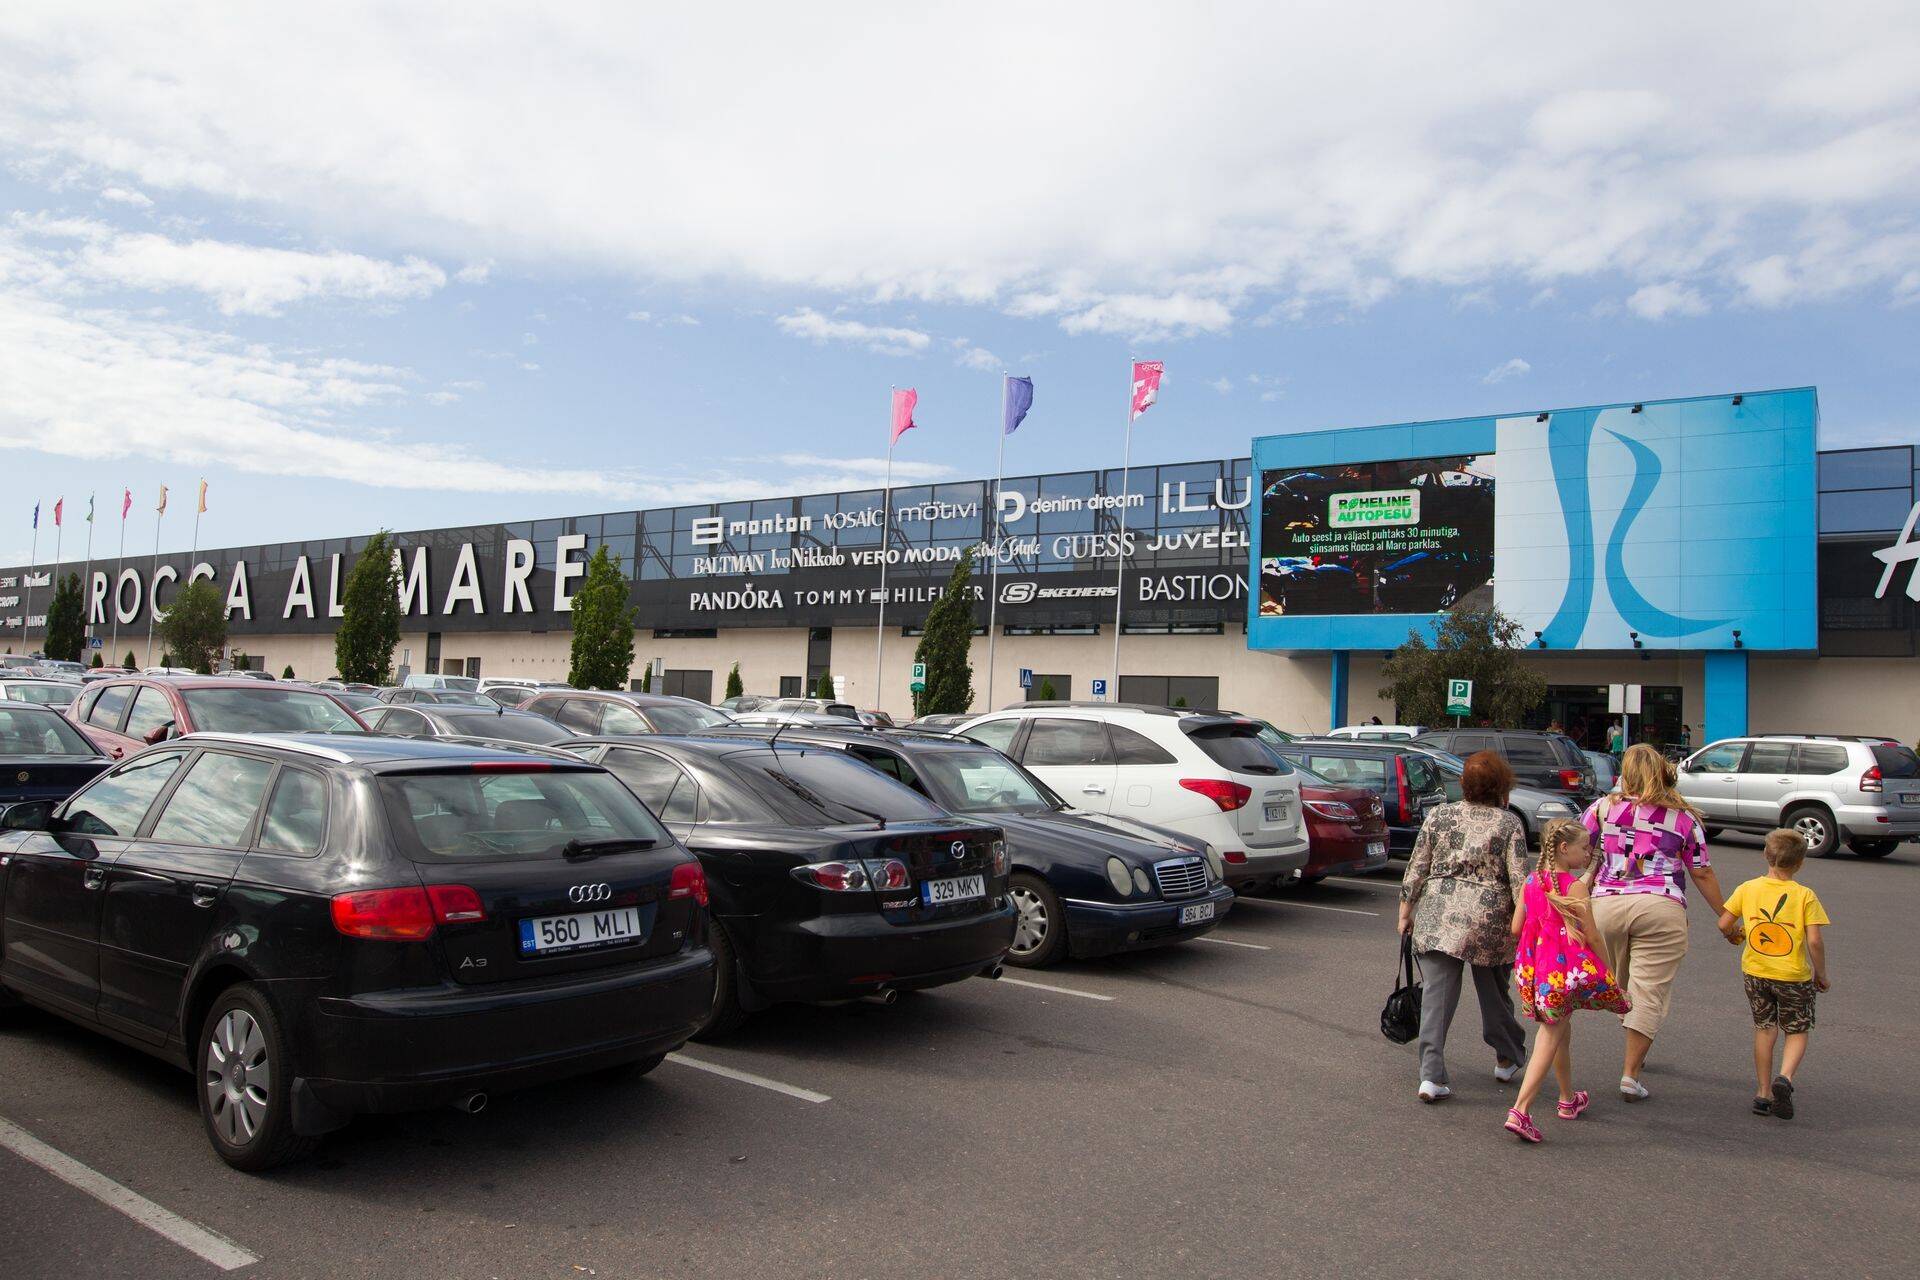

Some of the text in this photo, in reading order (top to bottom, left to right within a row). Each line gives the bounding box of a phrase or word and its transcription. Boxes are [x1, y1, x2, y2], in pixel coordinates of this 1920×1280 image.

[1030, 493, 1144, 514] denim dream
[730, 513, 812, 536] monton
[1338, 509, 1412, 522] AUTOPESU
[1291, 533, 1310, 543] Auto
[1311, 531, 1333, 542] seest
[1334, 531, 1342, 543] ja
[1372, 528, 1406, 541] puhtaks
[1407, 527, 1418, 538] 30
[1053, 532, 1136, 559] GUESS
[1309, 543, 1349, 554] siinsamas
[1351, 542, 1375, 552] Rocca
[1376, 540, 1384, 551] al
[1386, 540, 1407, 551] Mare
[693, 554, 765, 575] BALTMAN
[851, 546, 962, 566] VERO MODA
[388, 533, 587, 616] MARE
[794, 589, 866, 606] TOMMY
[1037, 586, 1119, 599] SKECHERS
[933, 875, 981, 900] 329 MKY
[541, 911, 632, 945] 560 MLI
[522, 939, 536, 948] EST
[459, 956, 487, 969] A3
